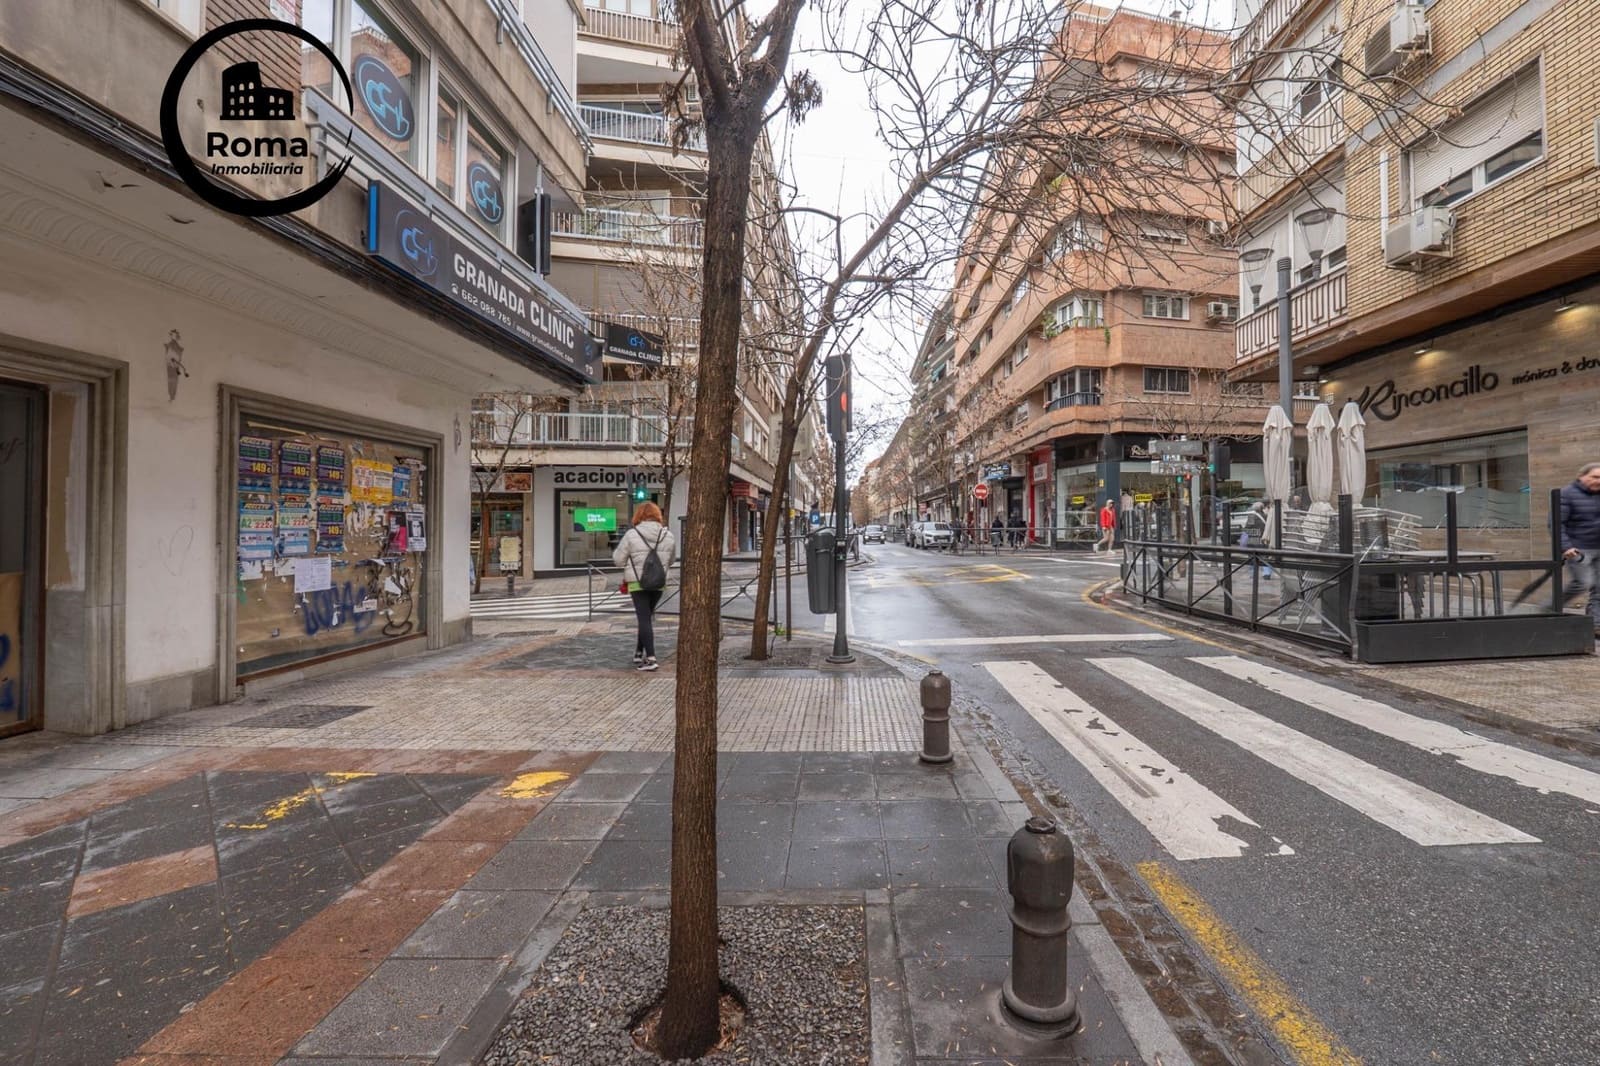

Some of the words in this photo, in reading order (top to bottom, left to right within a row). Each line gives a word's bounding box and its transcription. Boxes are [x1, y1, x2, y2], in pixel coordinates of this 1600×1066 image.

[454, 253, 526, 319] GRANADA
[530, 300, 574, 349] CLINIC
[461, 289, 478, 305] 662
[480, 302, 495, 317] 088
[498, 311, 512, 326] 785
[609, 346, 637, 357] GRANADA
[638, 351, 661, 363] CLINIC
[1512, 368, 1557, 385] mónica
[1561, 361, 1573, 375] &
[1358, 365, 1498, 421] Rinconcillo
